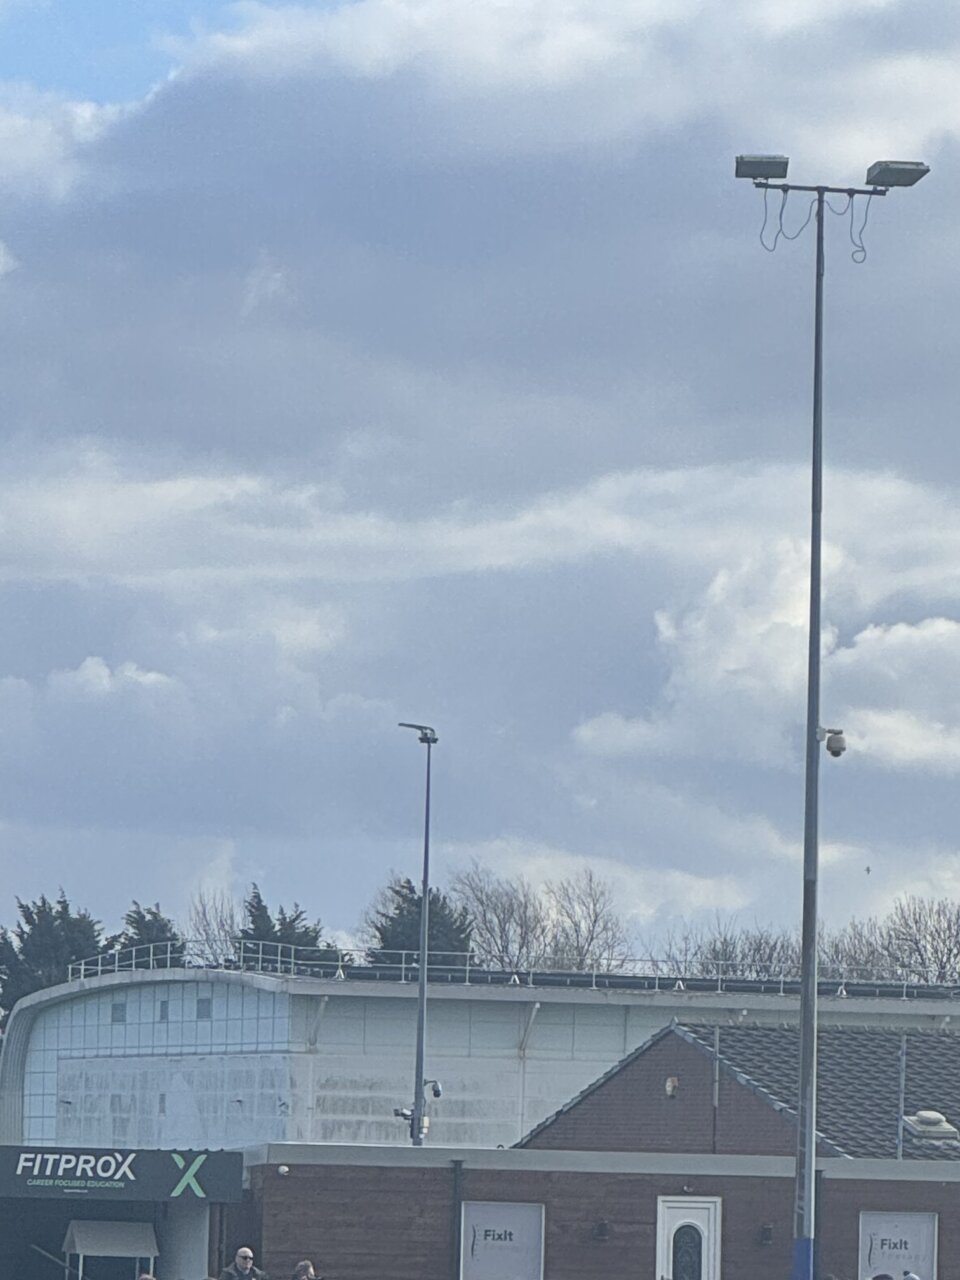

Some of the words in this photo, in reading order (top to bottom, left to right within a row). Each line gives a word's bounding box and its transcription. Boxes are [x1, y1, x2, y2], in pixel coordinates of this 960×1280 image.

[27, 1178, 54, 1187] CAREER
[55, 1179, 86, 1188] FOCUSED
[87, 1180, 125, 1189] EDUCATION
